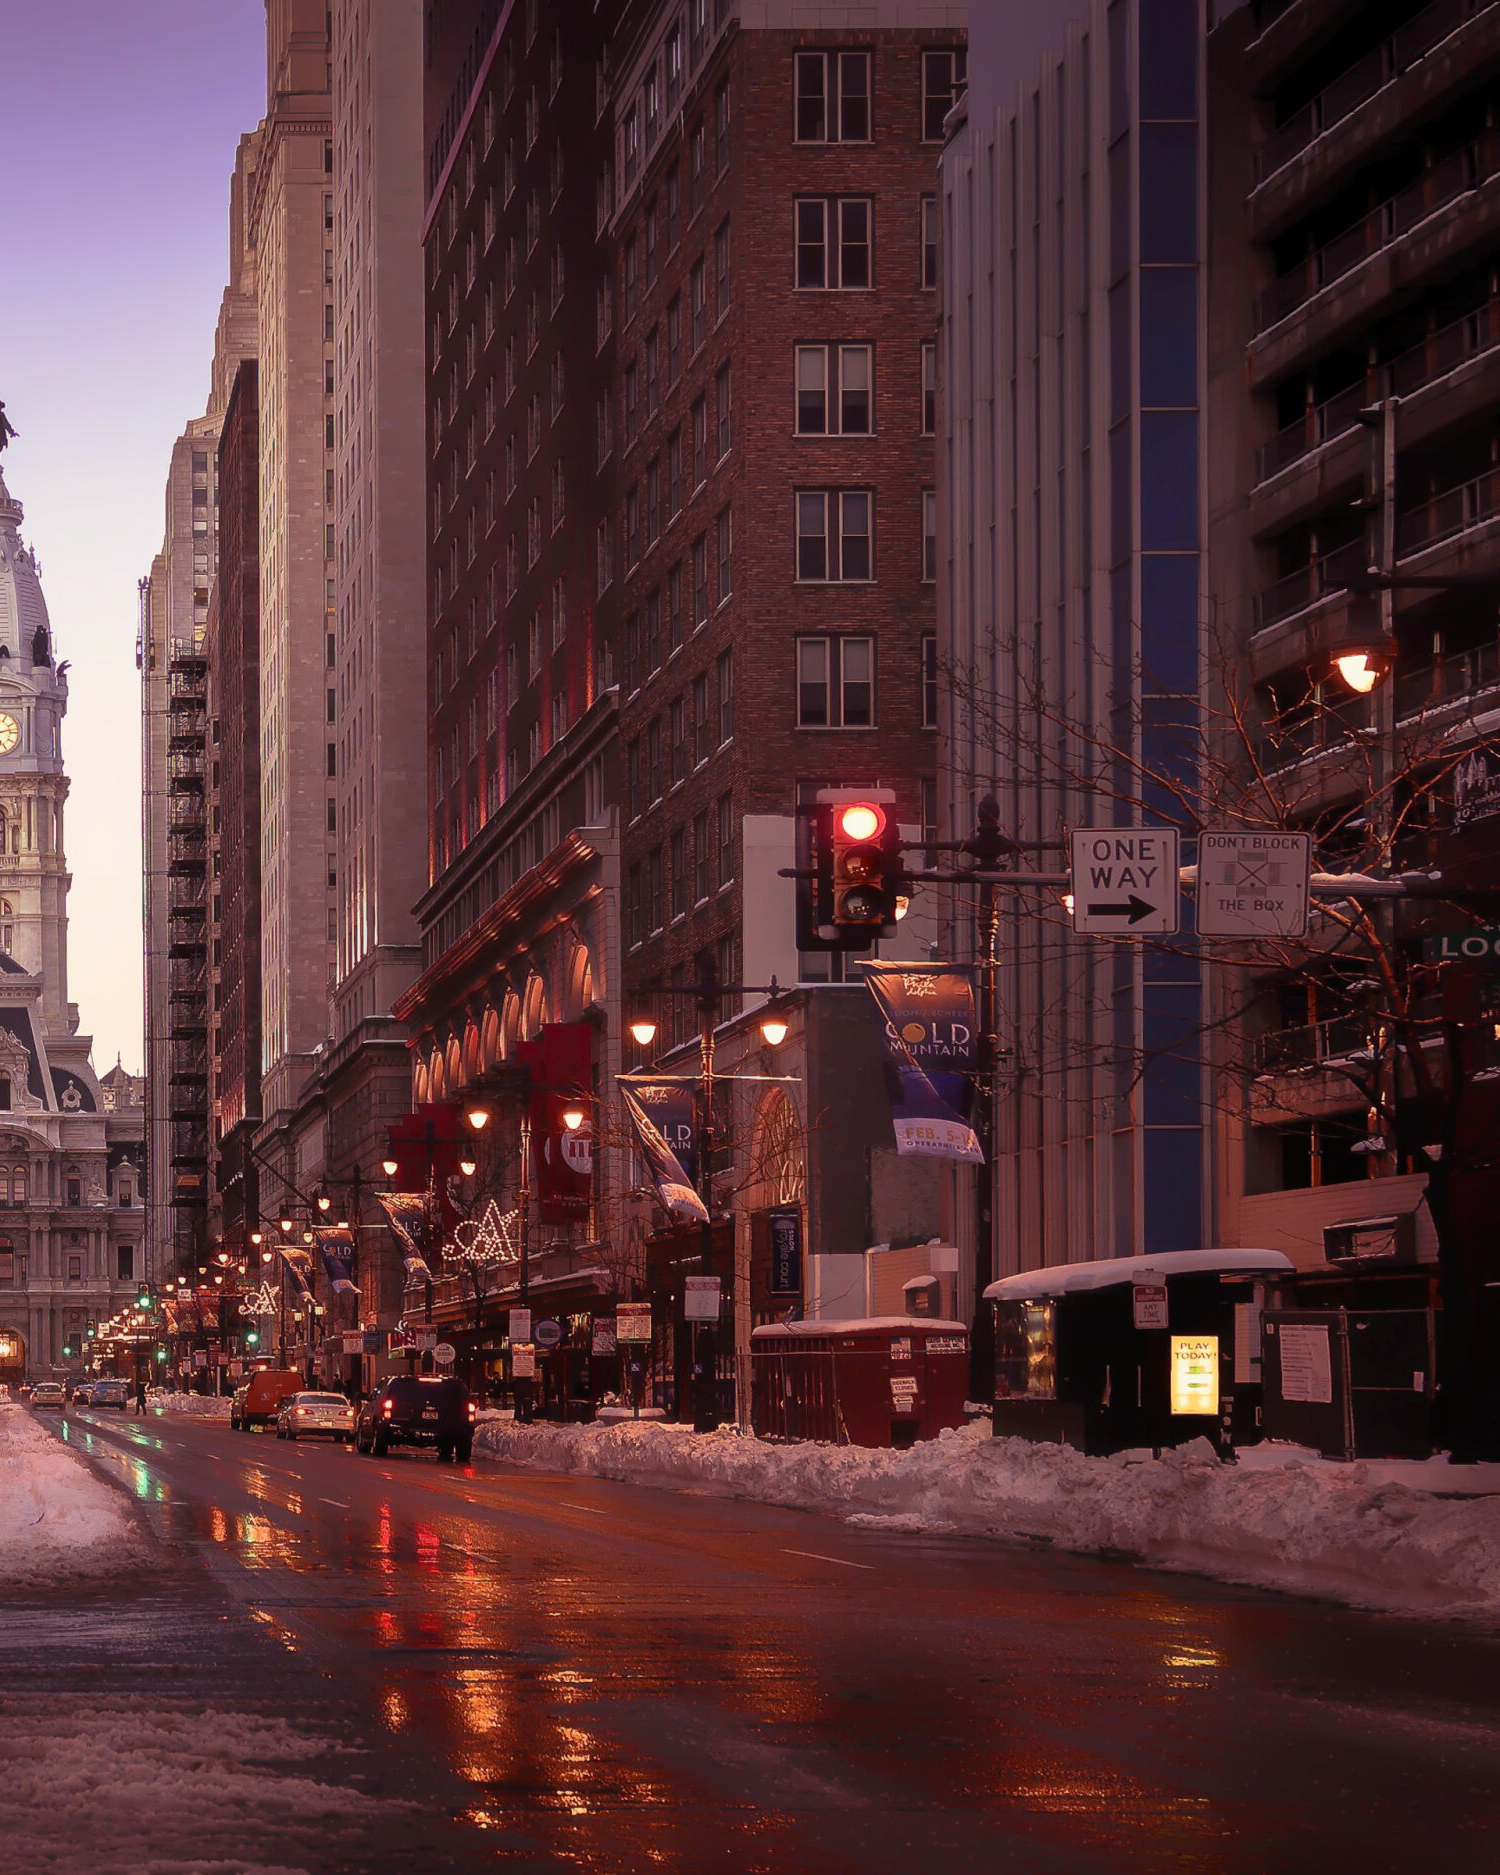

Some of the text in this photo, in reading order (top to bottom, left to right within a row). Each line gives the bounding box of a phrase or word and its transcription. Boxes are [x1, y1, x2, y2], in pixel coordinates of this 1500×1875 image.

[1093, 839, 1156, 861] ONE
[1252, 838, 1300, 850] BLOCK
[1090, 867, 1158, 889] WAY
[1218, 900, 1285, 911] THE BOX
[1442, 936, 1500, 957] LO
[885, 1022, 971, 1045] COLD
[890, 1040, 971, 1057] MUNTAIN
[905, 1128, 941, 1141] FEB.
[1143, 1304, 1158, 1312] ANY
[1143, 1311, 1161, 1319] TIME
[1180, 1342, 1210, 1350] PLAY
[1174, 1351, 1218, 1360] TODAY!
